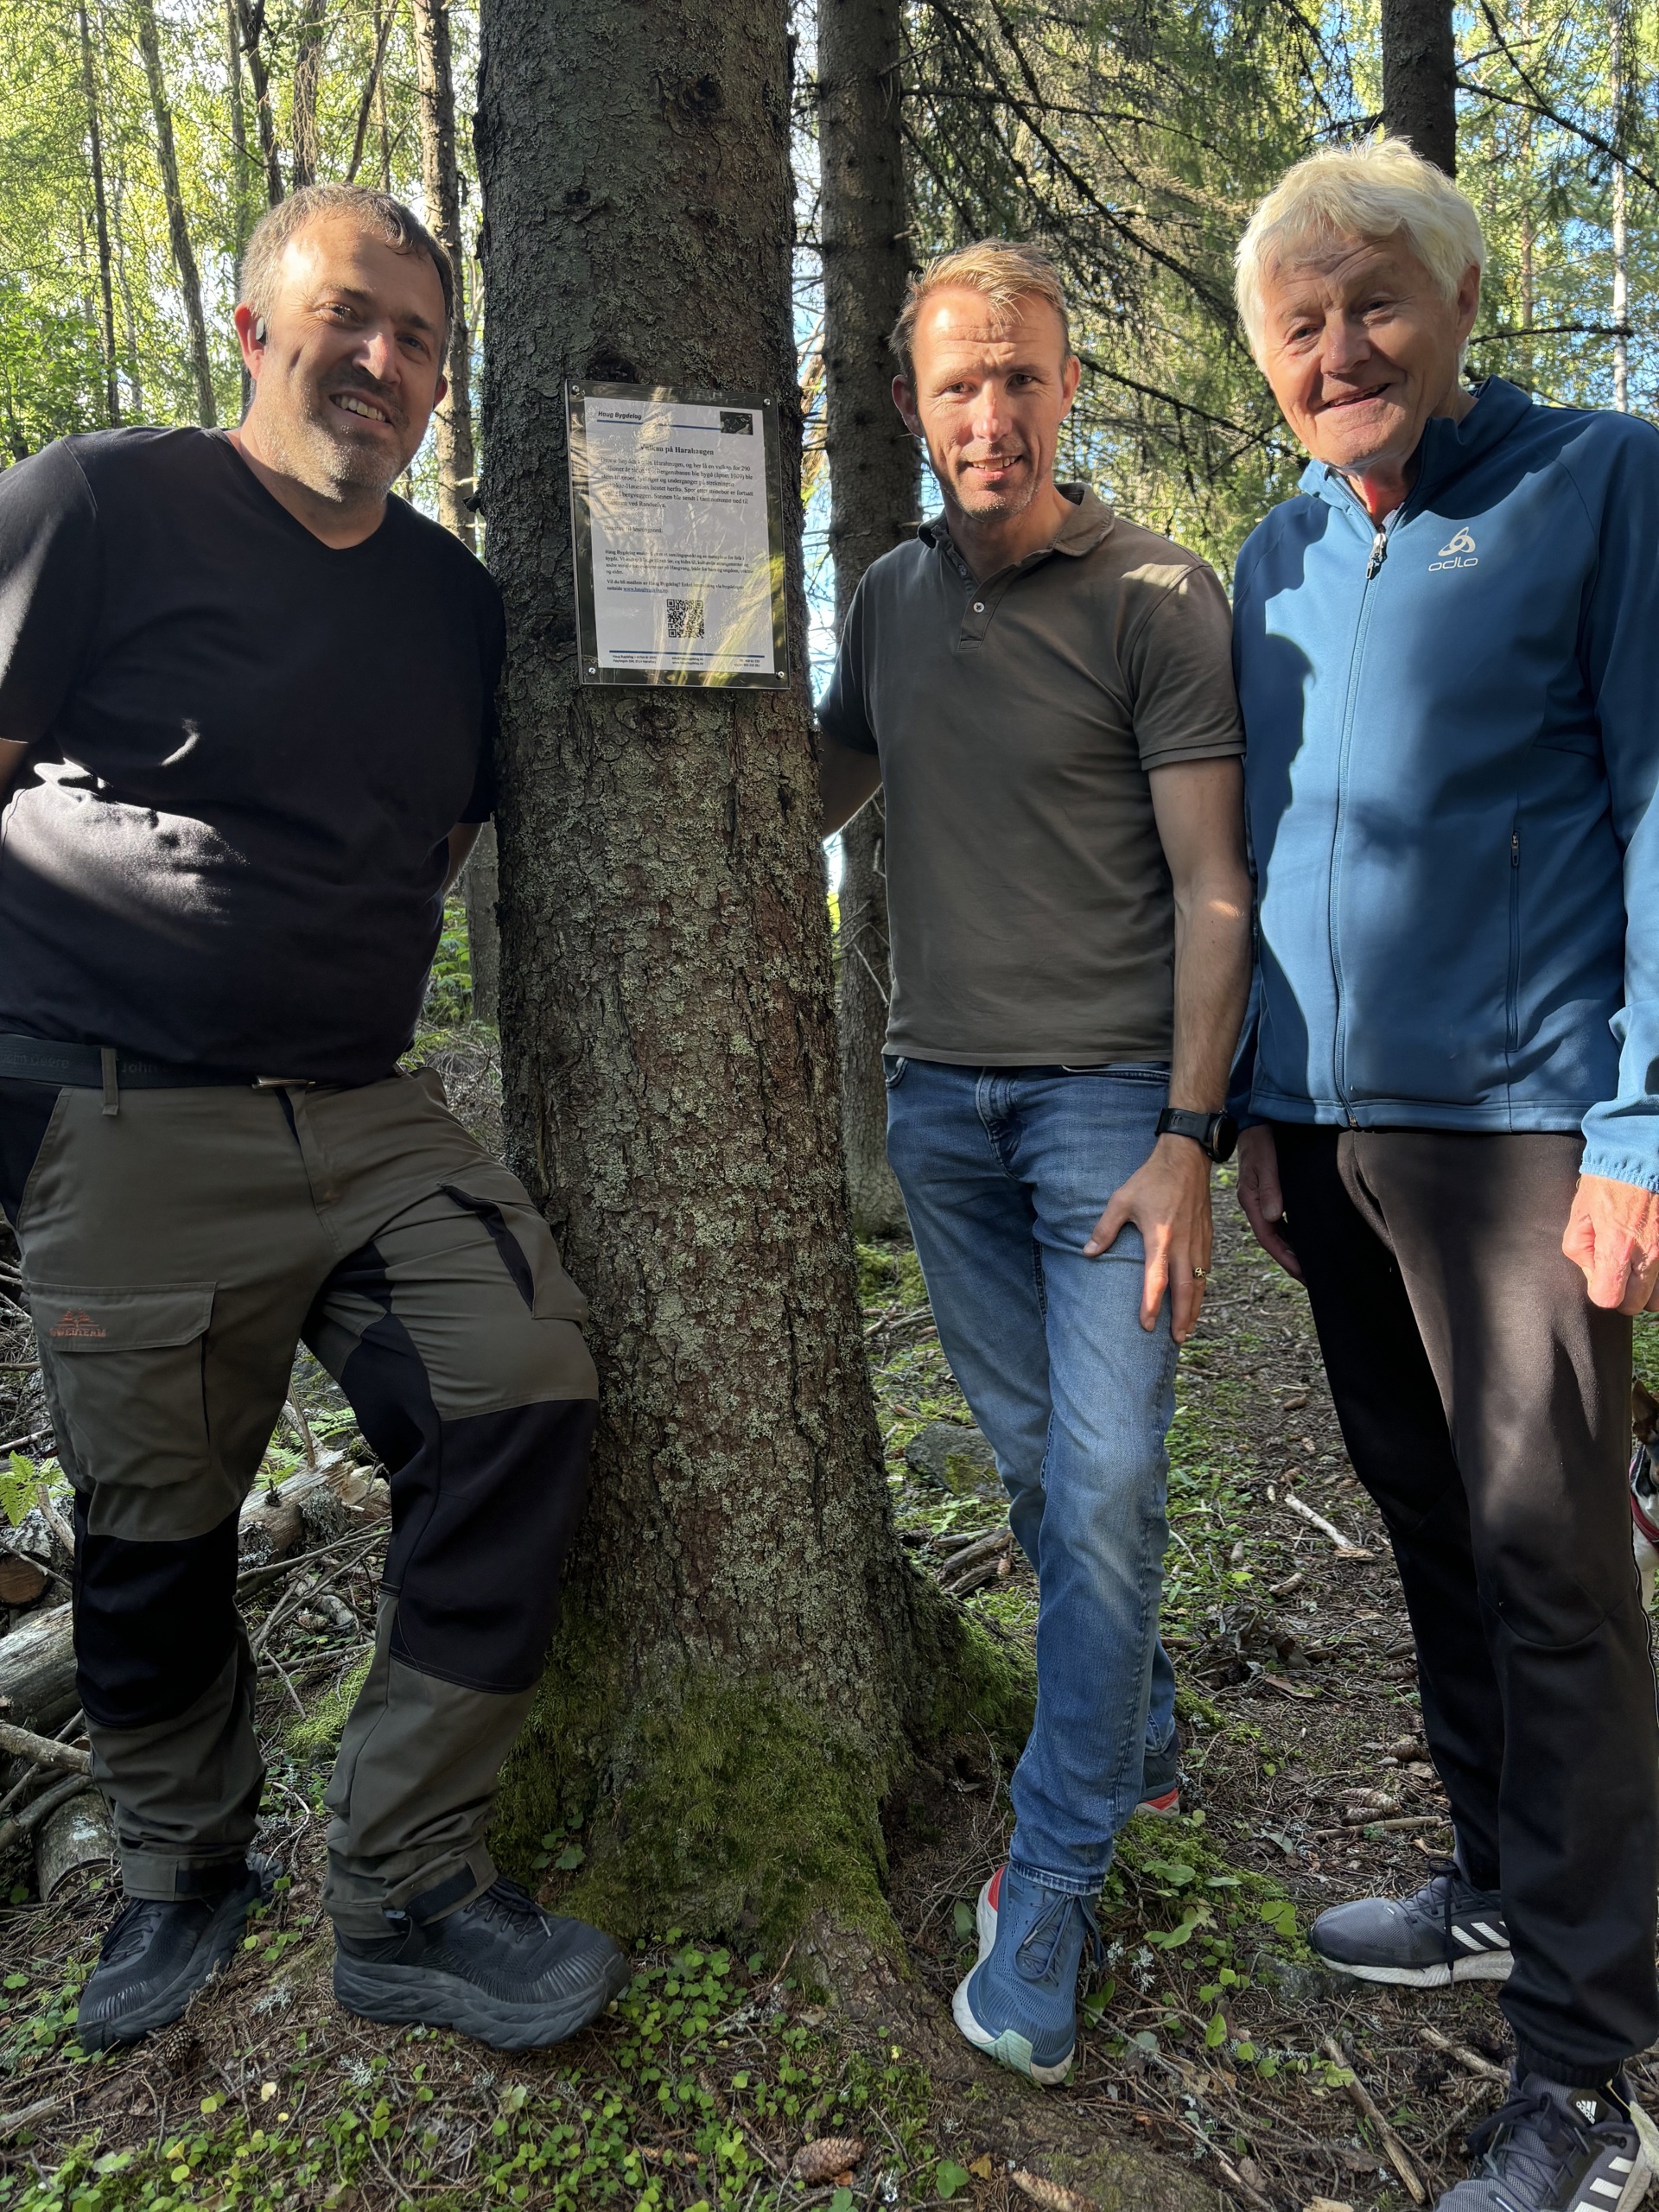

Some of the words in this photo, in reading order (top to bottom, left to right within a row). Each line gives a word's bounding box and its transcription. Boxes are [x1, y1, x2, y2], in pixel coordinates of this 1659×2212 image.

[614, 411, 642, 421] Bygdelag
[640, 444, 664, 453] Vulkan
[664, 446, 673, 454] på
[675, 446, 715, 456] Harahaugen
[1428, 556, 1478, 571] odlo
[1576, 2101, 1595, 2125] adidas
